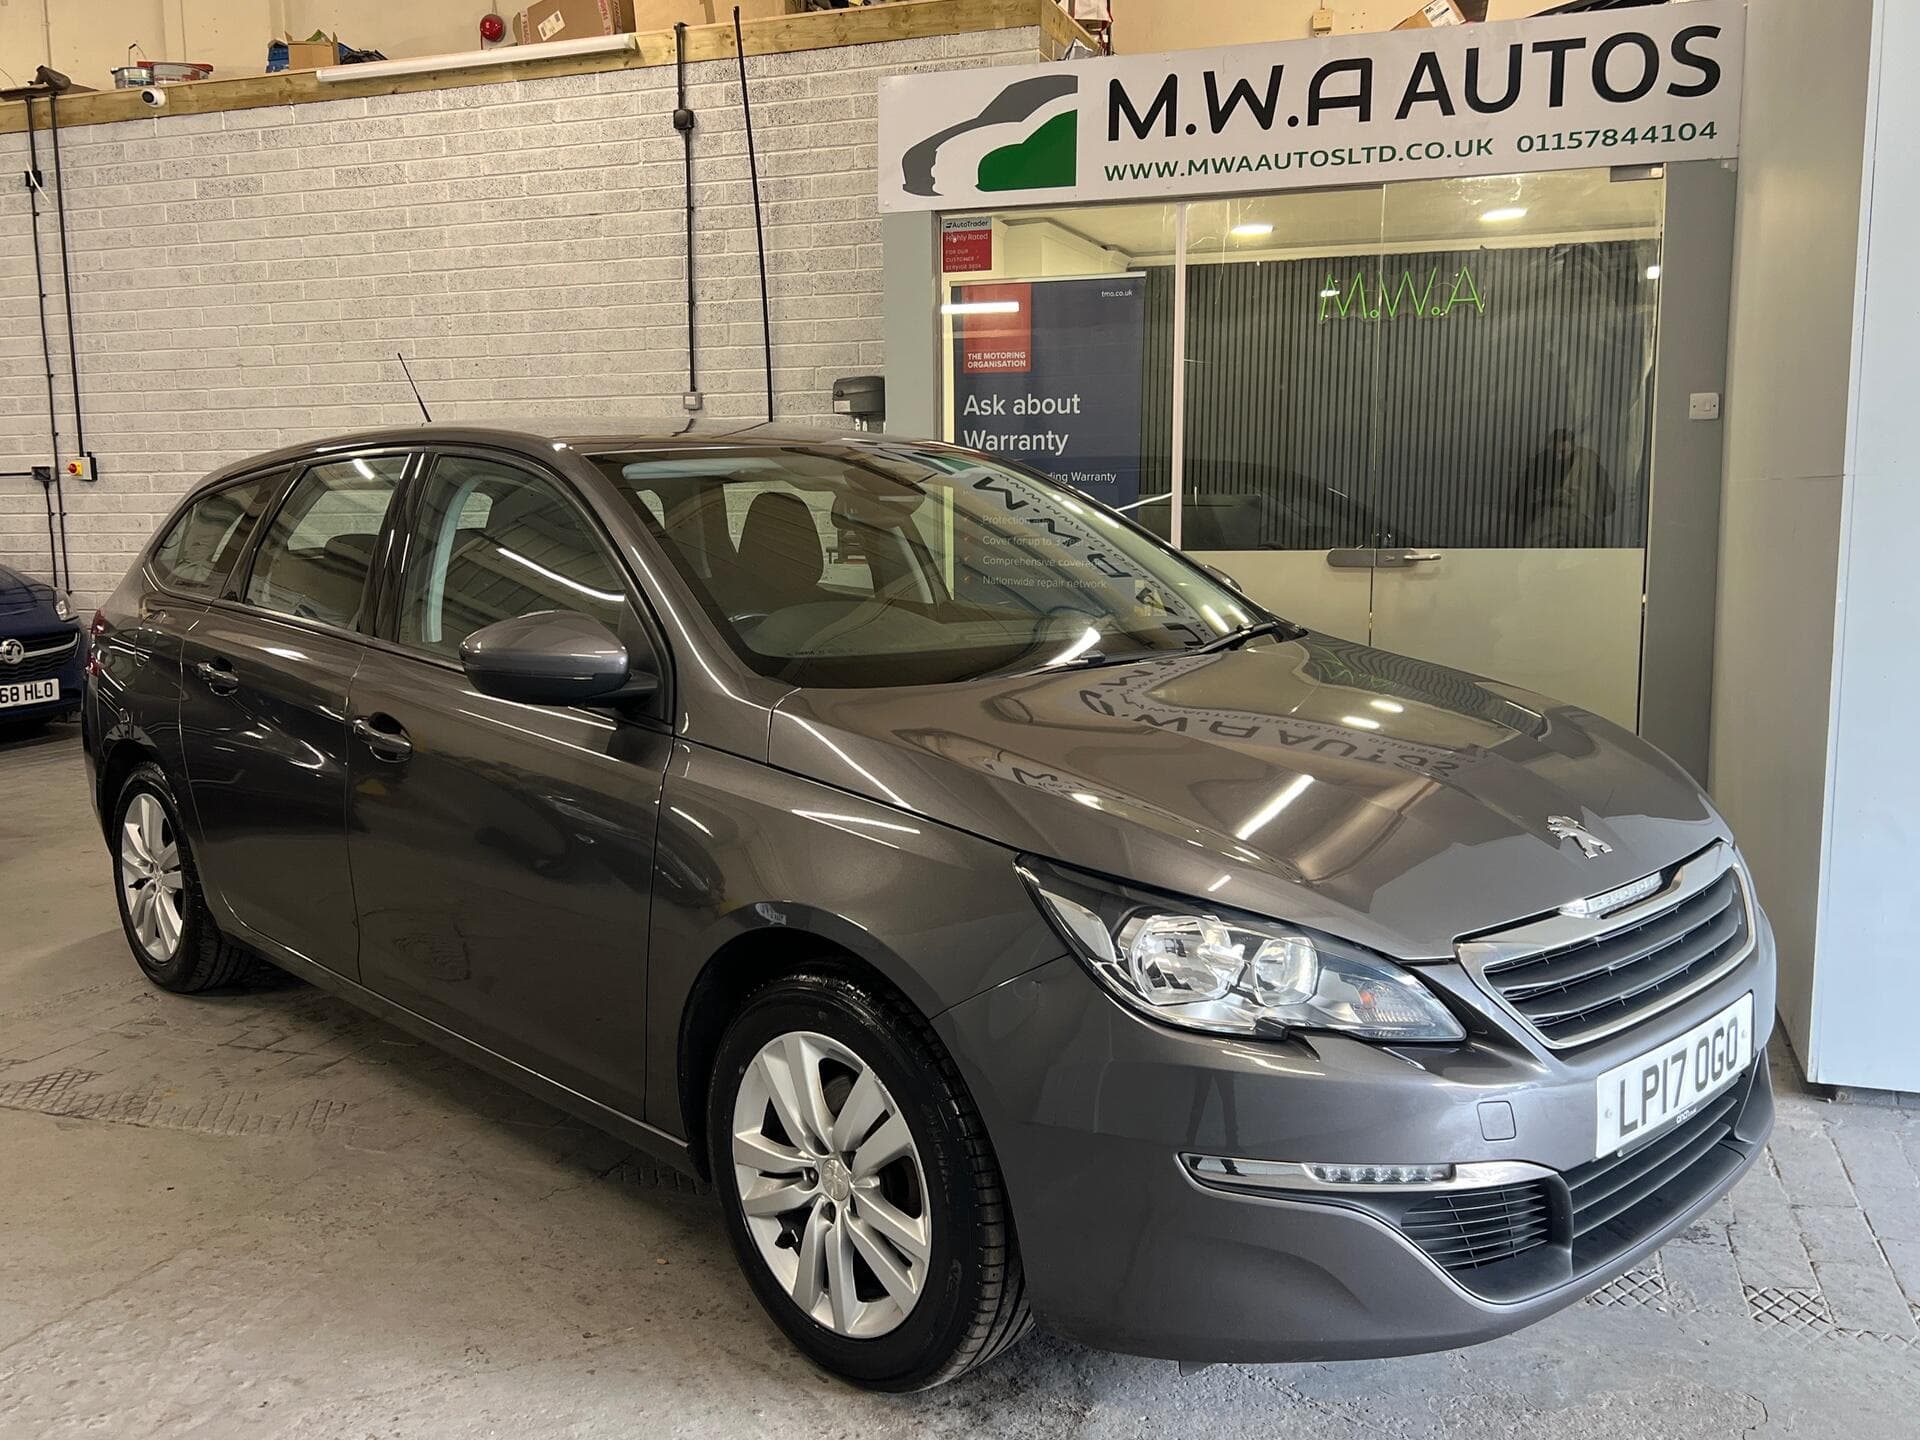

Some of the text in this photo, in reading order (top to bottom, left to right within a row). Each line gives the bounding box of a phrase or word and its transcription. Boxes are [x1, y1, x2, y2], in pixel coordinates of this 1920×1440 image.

[1108, 24, 1722, 142] M.W.A AUTOS
[1104, 121, 1718, 182] WWW.MWAAUTOSLTD.CO.UK 01157844104
[1101, 289, 1133, 298] tmo.co.uk
[1320, 265, 1484, 322] M.W.A
[967, 351, 1026, 361] THE MOTORING
[967, 360, 1027, 369] ORGANISATION
[963, 393, 1081, 416] Ask about
[963, 429, 1069, 457] Warranty
[1070, 471, 1117, 484] Warranty
[982, 515, 1031, 525] Protection
[1028, 537, 1041, 549] up
[982, 576, 1035, 586] Nationwide
[0, 682, 53, 703] 68 HLO
[1619, 1016, 1738, 1139] LP17 OGO
